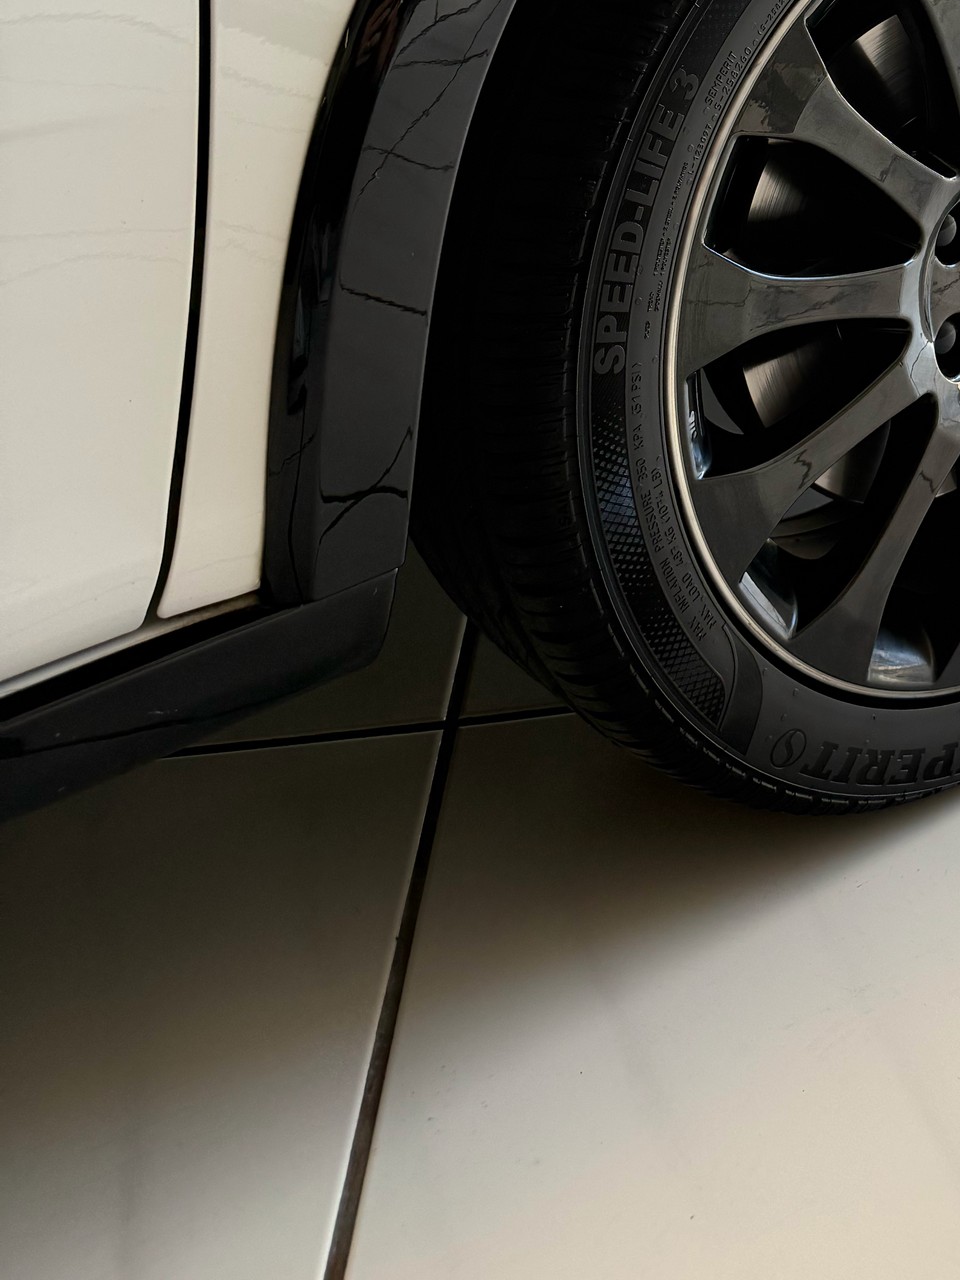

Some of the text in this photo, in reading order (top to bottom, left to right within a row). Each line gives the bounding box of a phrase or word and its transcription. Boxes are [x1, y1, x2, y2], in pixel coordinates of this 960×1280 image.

[703, 50, 737, 106] SEMPERIT
[594, 65, 700, 375] SPEED-LIFE 3
[631, 422, 644, 451] KPA
[634, 454, 648, 483] 350
[640, 488, 665, 554] PRESSURE
[664, 524, 677, 546] KG
[659, 555, 691, 614] INFLATION
[680, 569, 701, 603] LOAD
